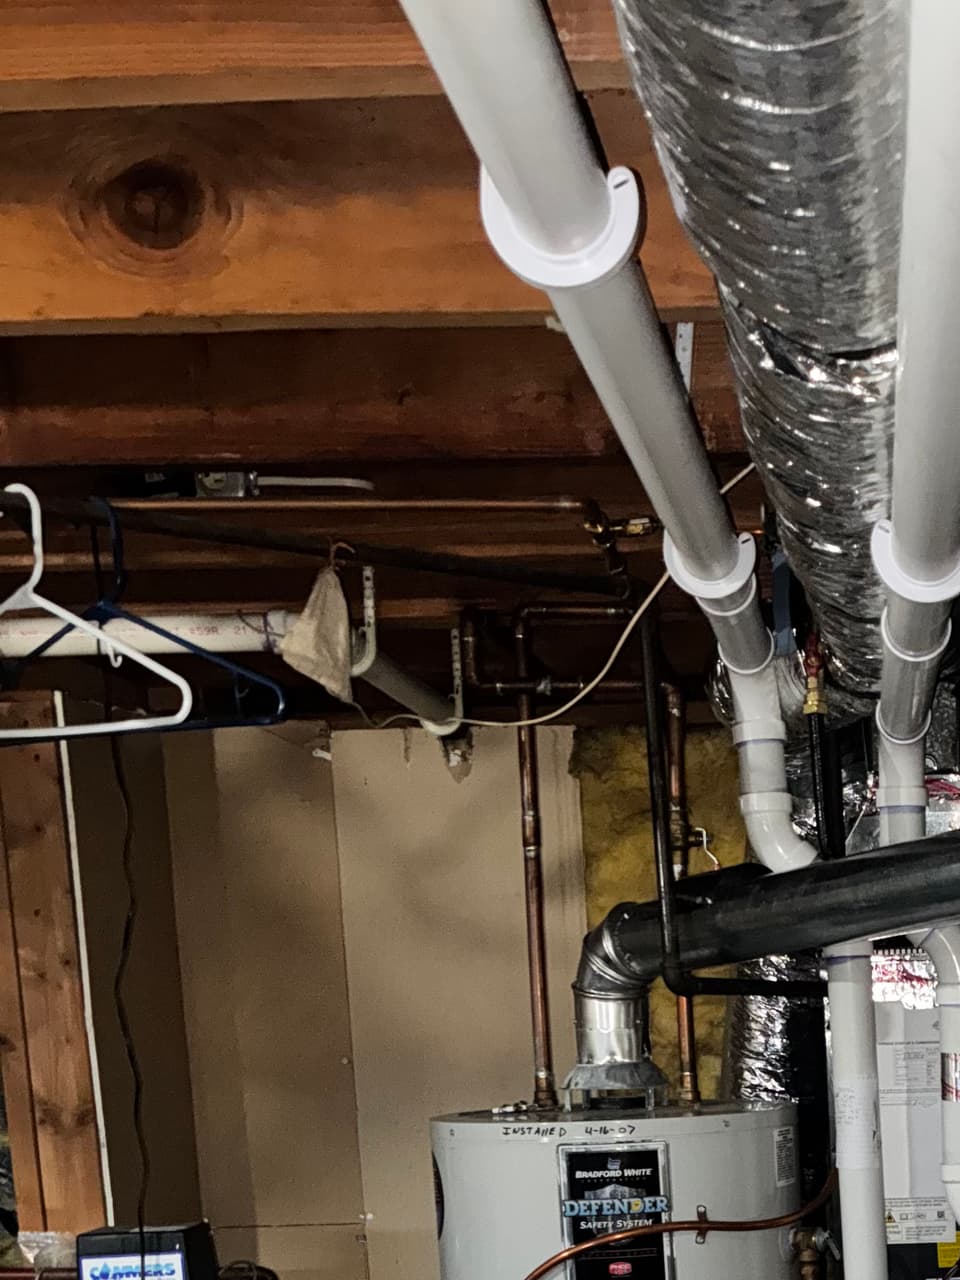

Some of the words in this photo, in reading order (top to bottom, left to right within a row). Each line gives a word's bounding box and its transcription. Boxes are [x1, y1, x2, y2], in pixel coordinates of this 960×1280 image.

[575, 1169, 622, 1179] BRADFORD
[623, 1168, 653, 1177] WHITE
[564, 1196, 669, 1217] DEFENDER
[580, 1220, 614, 1230] SAFETY
[616, 1219, 653, 1229] SYSTEM
